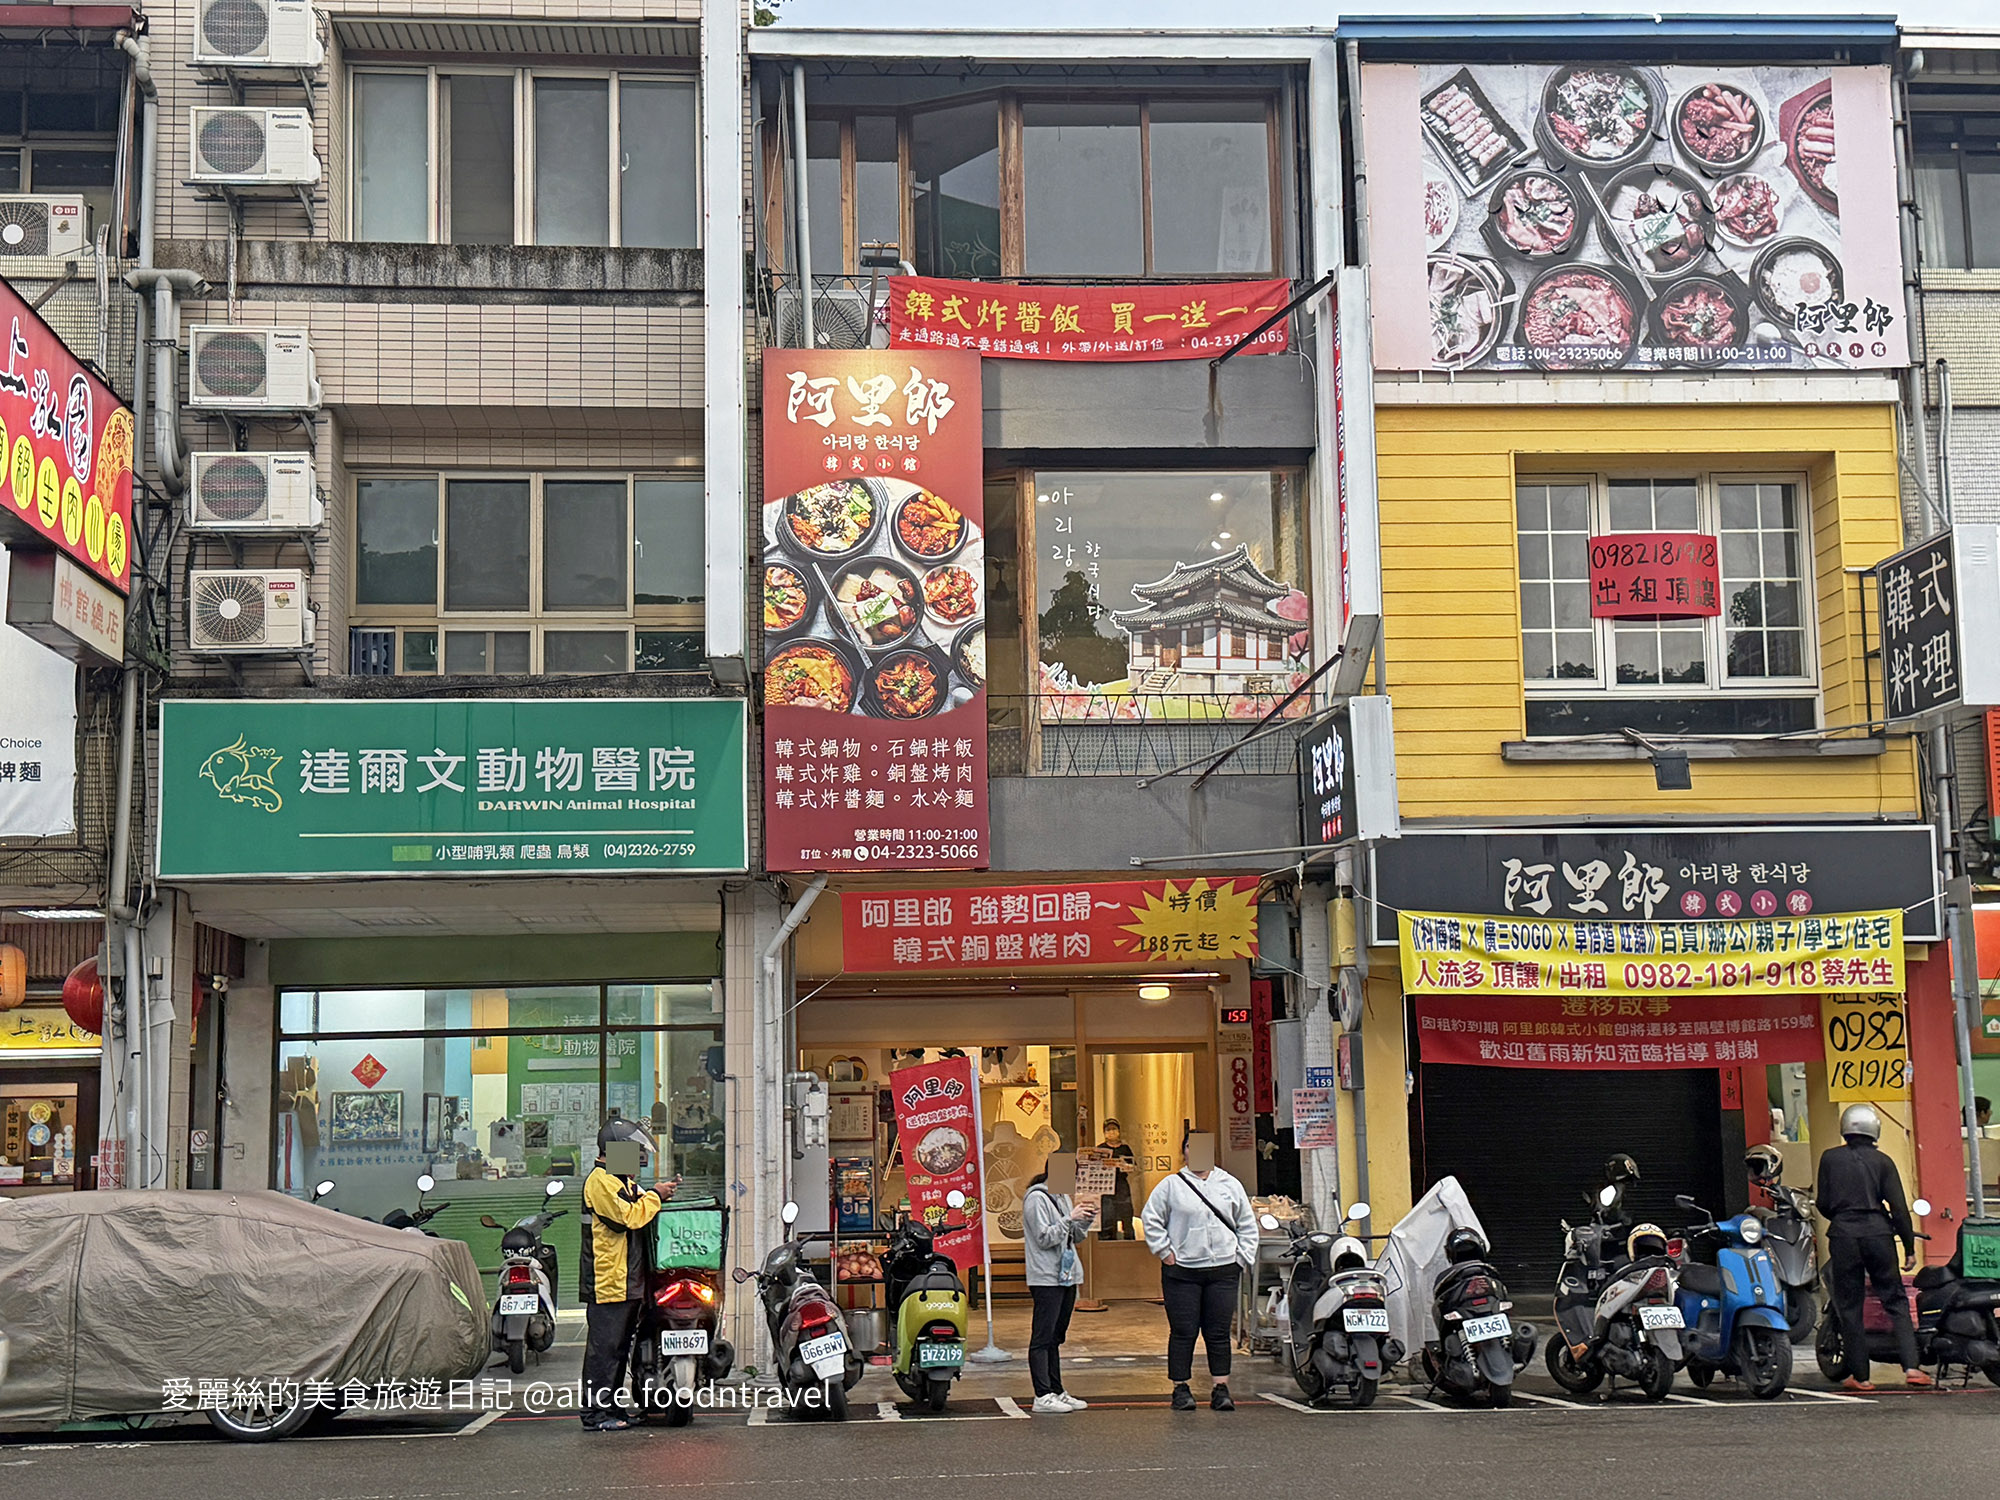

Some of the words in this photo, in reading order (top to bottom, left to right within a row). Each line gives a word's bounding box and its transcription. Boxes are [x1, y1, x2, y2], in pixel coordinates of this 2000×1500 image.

[904, 289, 1085, 335] 韓式炸醬飯
[1795, 296, 1894, 337] 阿里郎
[1062, 338, 1165, 354] 外帶/外送/訂位
[1807, 344, 1885, 357] 韓式小館
[786, 366, 955, 436] 阿里郎
[823, 434, 869, 450] 아리랑
[874, 434, 920, 450] 한식당
[825, 456, 920, 472] 韓式小館
[1051, 487, 1076, 567] 아리랑
[1592, 541, 1716, 568] 0982181918
[269, 582, 295, 590] HITACHI
[1596, 576, 1716, 609] 出租頂讓
[1885, 552, 1951, 640] 韓式
[1889, 630, 1957, 712] 料理
[0, 737, 42, 748] Choice
[300, 746, 695, 794] 達爾文動物醫院
[478, 799, 563, 811] DARWIN
[566, 799, 623, 811] Animal
[628, 799, 695, 812] Hospital
[854, 829, 905, 841] 營業時間
[908, 829, 978, 841] 11:00-21:00
[436, 845, 515, 861] 小型哺乳類
[520, 845, 551, 860] 爬蟲
[557, 843, 590, 860] 鳥類
[603, 843, 696, 859] (04)2326-2759
[801, 849, 852, 860] 訂位、外帶
[871, 845, 979, 860] 04-2323-5066
[1502, 850, 1671, 920] 阿里郎
[1680, 863, 1741, 885] 아리랑
[1749, 863, 1811, 885] 한식당
[861, 896, 953, 928] 阿里郎
[1169, 890, 1218, 912] 特價
[1684, 893, 1807, 913] 韓式小館
[1483, 920, 1552, 953] 廣三SOGO
[893, 932, 1091, 964] 韓式銅盤烤肉
[1415, 959, 1485, 989] 人流多
[1624, 960, 1817, 989] 0982-181-918
[1822, 958, 1894, 987] 蔡先生
[1228, 1010, 1248, 1023] 159
[1421, 1016, 1499, 1034] 因租約到期
[1829, 1010, 1906, 1052] 0982
[1715, 1039, 1759, 1061] 謝謝
[1315, 1079, 1333, 1087] 159
[1831, 1059, 1905, 1089] 181918
[902, 1077, 965, 1110] 阿里郎
[670, 1226, 709, 1240] Uber
[670, 1241, 708, 1257] Eats
[1971, 1243, 1996, 1256] Uber
[1971, 1256, 1999, 1269] Eats
[663, 1336, 706, 1350] NNH-8697
